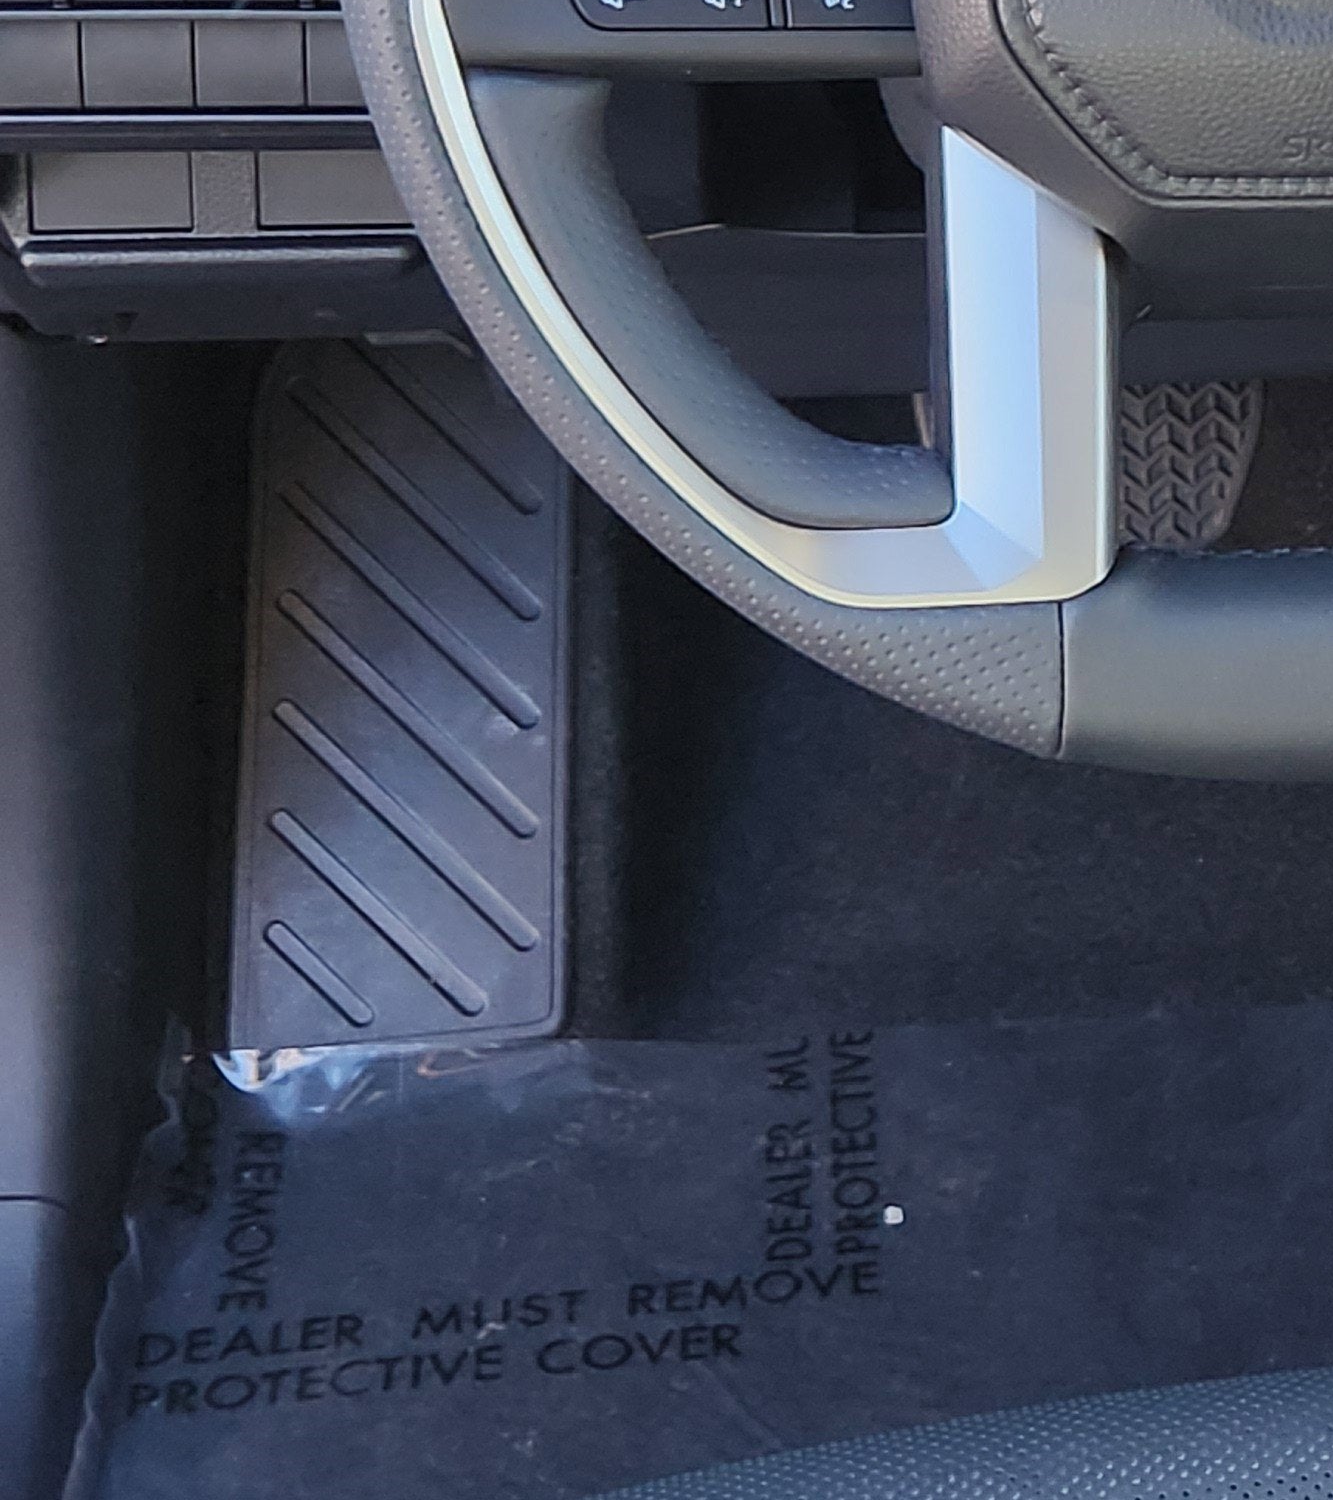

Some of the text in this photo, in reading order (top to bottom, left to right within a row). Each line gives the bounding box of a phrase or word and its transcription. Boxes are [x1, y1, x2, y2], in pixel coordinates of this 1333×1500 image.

[764, 1118, 812, 1263] DEALER
[828, 1030, 881, 1256] PROTECTIVE
[216, 1130, 289, 1312] REMOVE
[125, 1323, 743, 1417] PROTECTIVE COVER
[133, 1260, 880, 1370] DEALER MUST REMOVE
